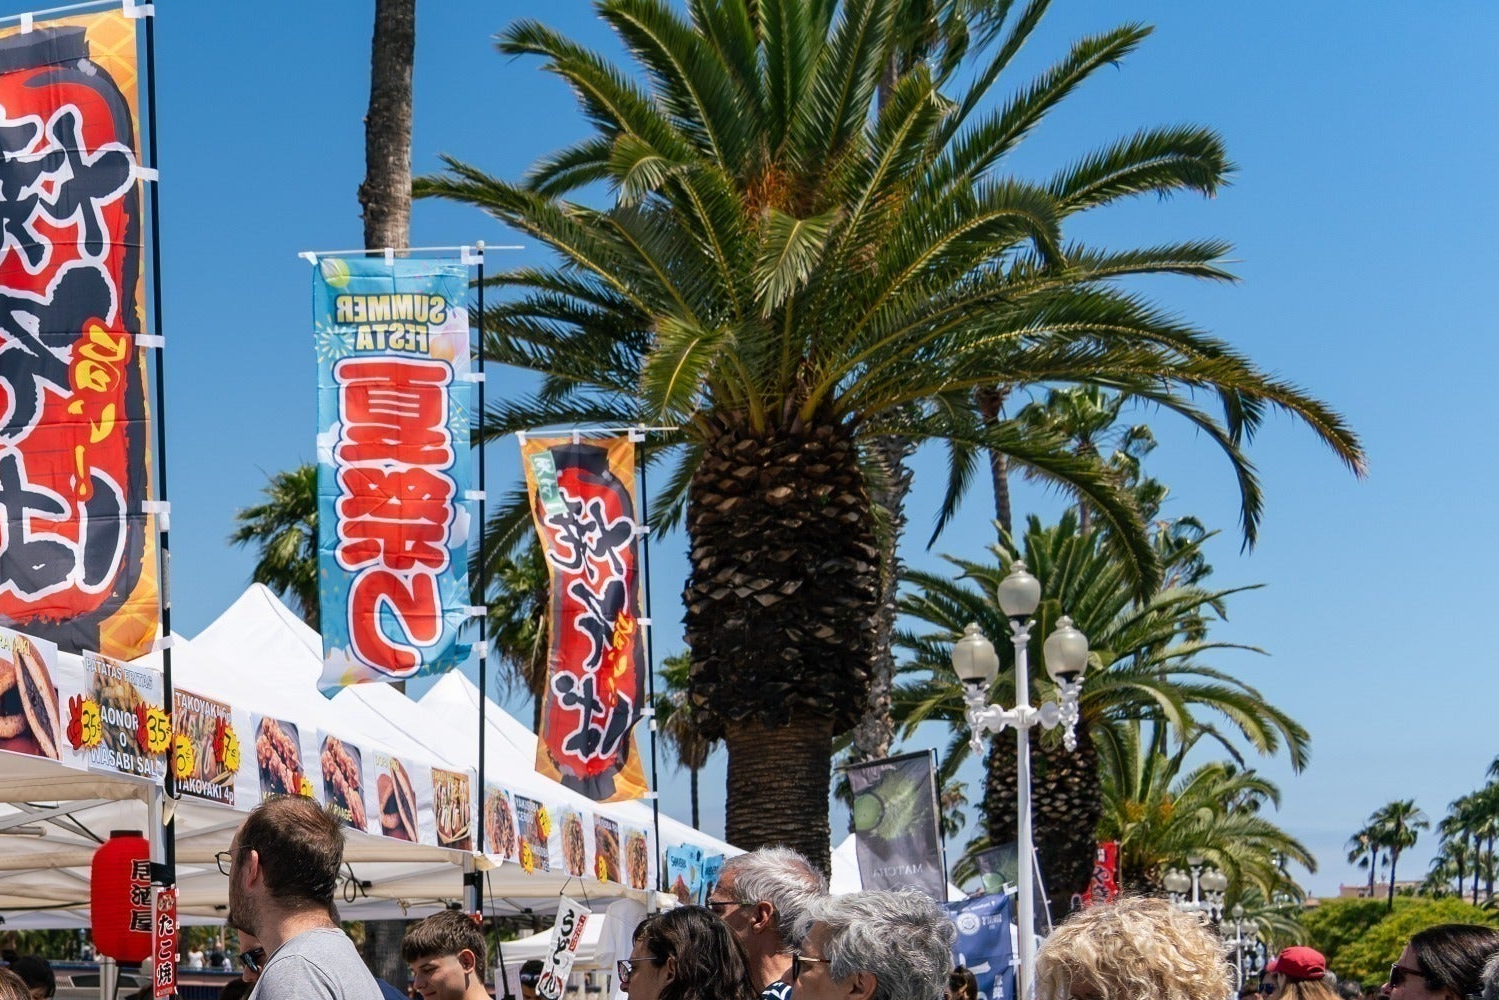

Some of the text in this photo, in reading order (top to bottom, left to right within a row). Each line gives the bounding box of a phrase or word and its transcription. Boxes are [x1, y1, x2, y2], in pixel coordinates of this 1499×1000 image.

[85, 656, 153, 690] PATATAS FRITAS
[101, 704, 138, 731] AONOR
[119, 731, 127, 748] O
[90, 747, 158, 776] WASABI SAL
[177, 777, 222, 800] TAKOYAKI
[156, 913, 174, 987] たこ焼
